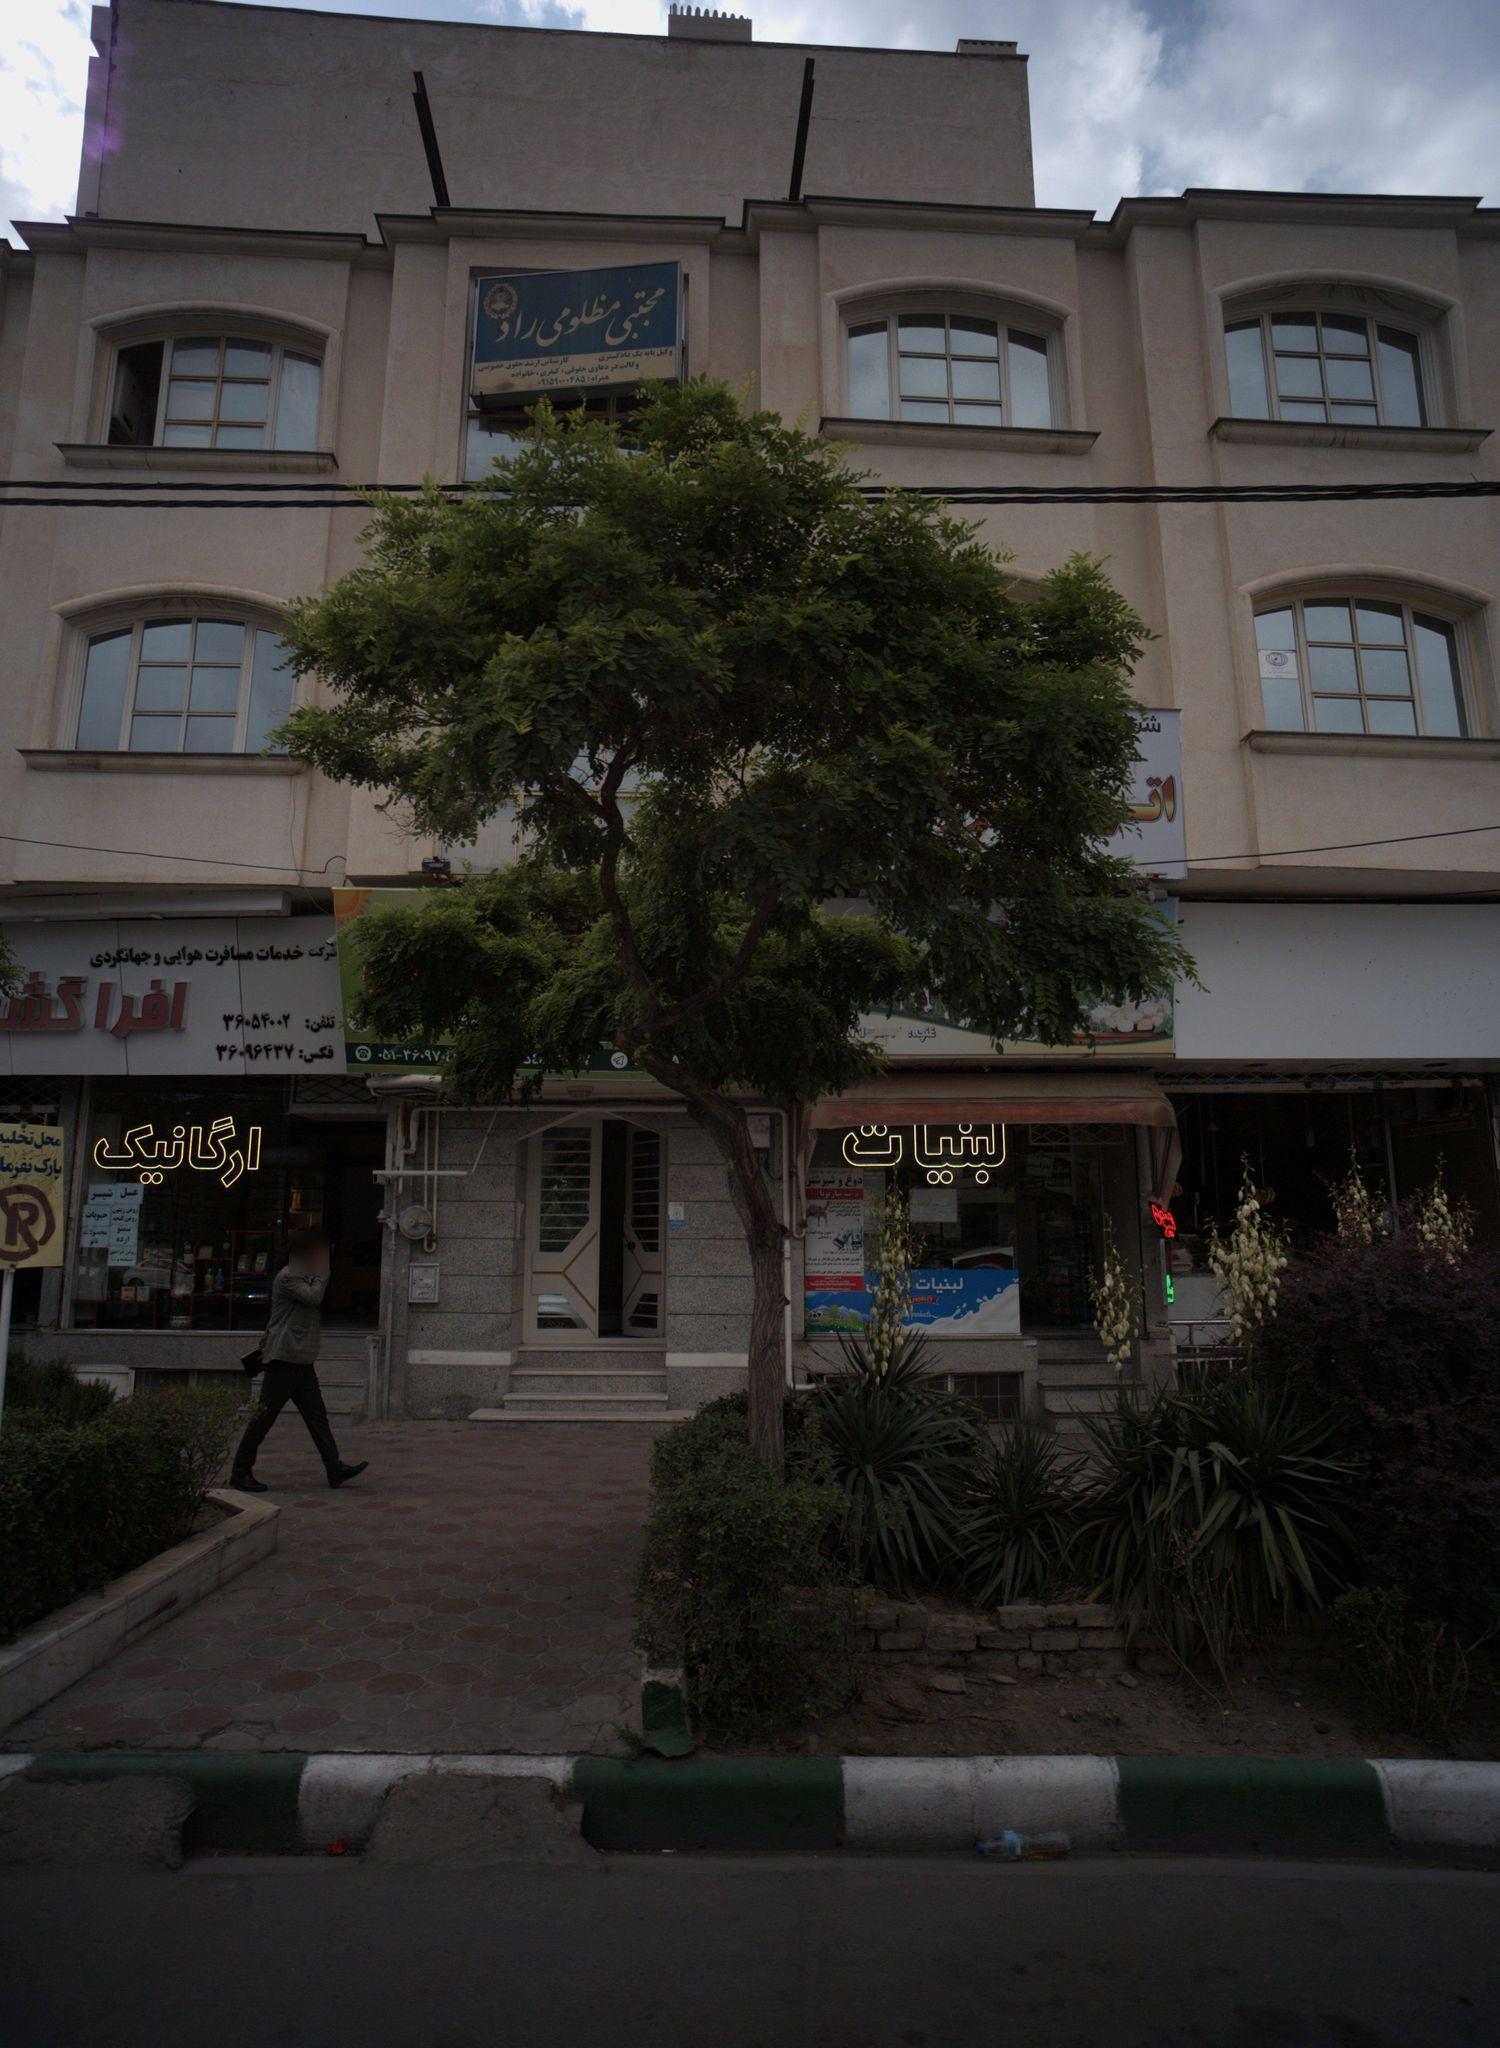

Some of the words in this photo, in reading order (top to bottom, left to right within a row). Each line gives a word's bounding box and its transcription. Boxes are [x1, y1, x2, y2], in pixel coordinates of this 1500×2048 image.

[536, 293, 621, 347] مظلومی
[605, 287, 666, 346] مجتبی
[90, 947, 150, 968] جهانگردی
[153, 951, 161, 965] و
[164, 945, 202, 966] هوایی
[205, 945, 254, 965] مسافرت
[256, 945, 303, 960] خدمات
[0, 971, 88, 1031] گش
[94, 979, 189, 1040] افرا
[34, 1131, 61, 1149] محل
[94, 1116, 262, 1189] ارگانیک
[842, 1123, 1006, 1185] لبنیات
[34, 1158, 62, 1180] پارک
[915, 1277, 964, 1294] لبنیات
